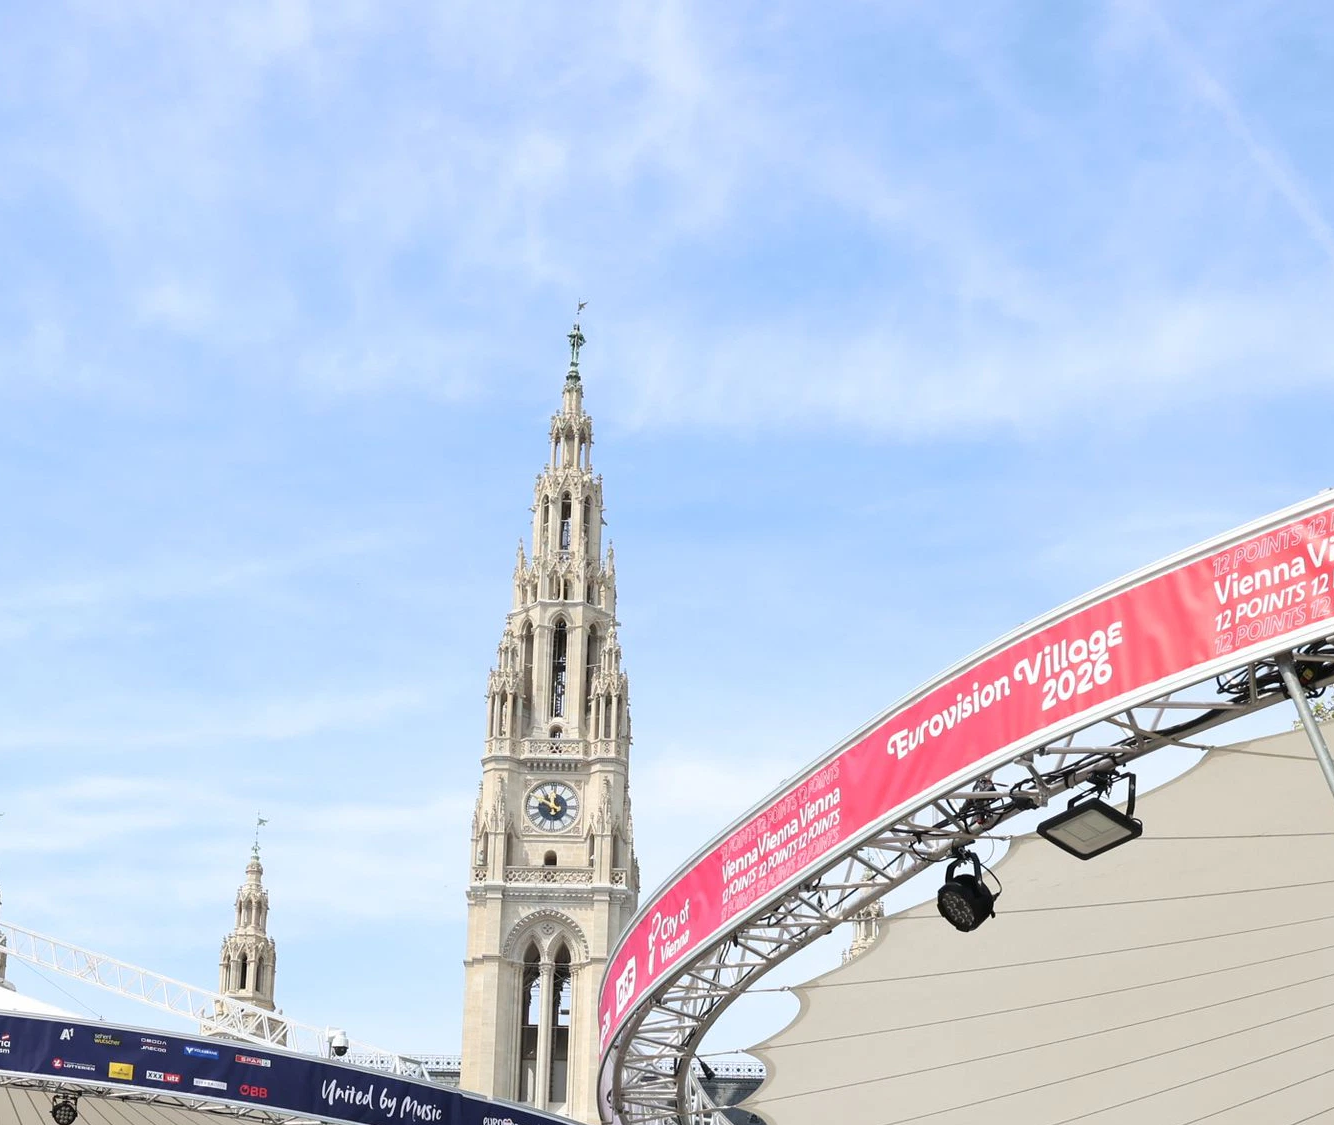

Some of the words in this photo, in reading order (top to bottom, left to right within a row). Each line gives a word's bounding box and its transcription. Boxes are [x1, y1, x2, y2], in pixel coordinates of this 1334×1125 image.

[1213, 553, 1230, 578] 12
[1232, 524, 1303, 569] POINTS
[1307, 517, 1327, 539] 12
[1214, 555, 1306, 605] Vienna
[1215, 609, 1232, 632] 12
[1234, 581, 1306, 624] POINTS
[1311, 573, 1329, 597] 12
[1215, 631, 1233, 655] 12
[1235, 603, 1307, 646] POINTS
[1310, 596, 1331, 619] 12
[887, 675, 1010, 759] Eurovision
[1014, 621, 1123, 685] Village
[1041, 653, 1113, 711] 2026
[722, 847, 758, 884] Vienna
[758, 818, 799, 856] Vienna
[799, 787, 840, 828] Vienna
[722, 888, 729, 905] 12
[728, 866, 757, 900] POINTS
[759, 861, 767, 878] 12
[767, 839, 798, 873] POINTS
[798, 832, 807, 850] 12
[807, 808, 840, 844] POINTS
[661, 913, 678, 940] City
[680, 898, 690, 925] of
[661, 930, 690, 964] Vienna
[59, 1027, 74, 1040] A1
[240, 1055, 262, 1065] SPAR
[63, 1062, 96, 1072] LOTTERIEN
[321, 1079, 374, 1107] United
[379, 1091, 397, 1117] by
[400, 1096, 443, 1122] Music
